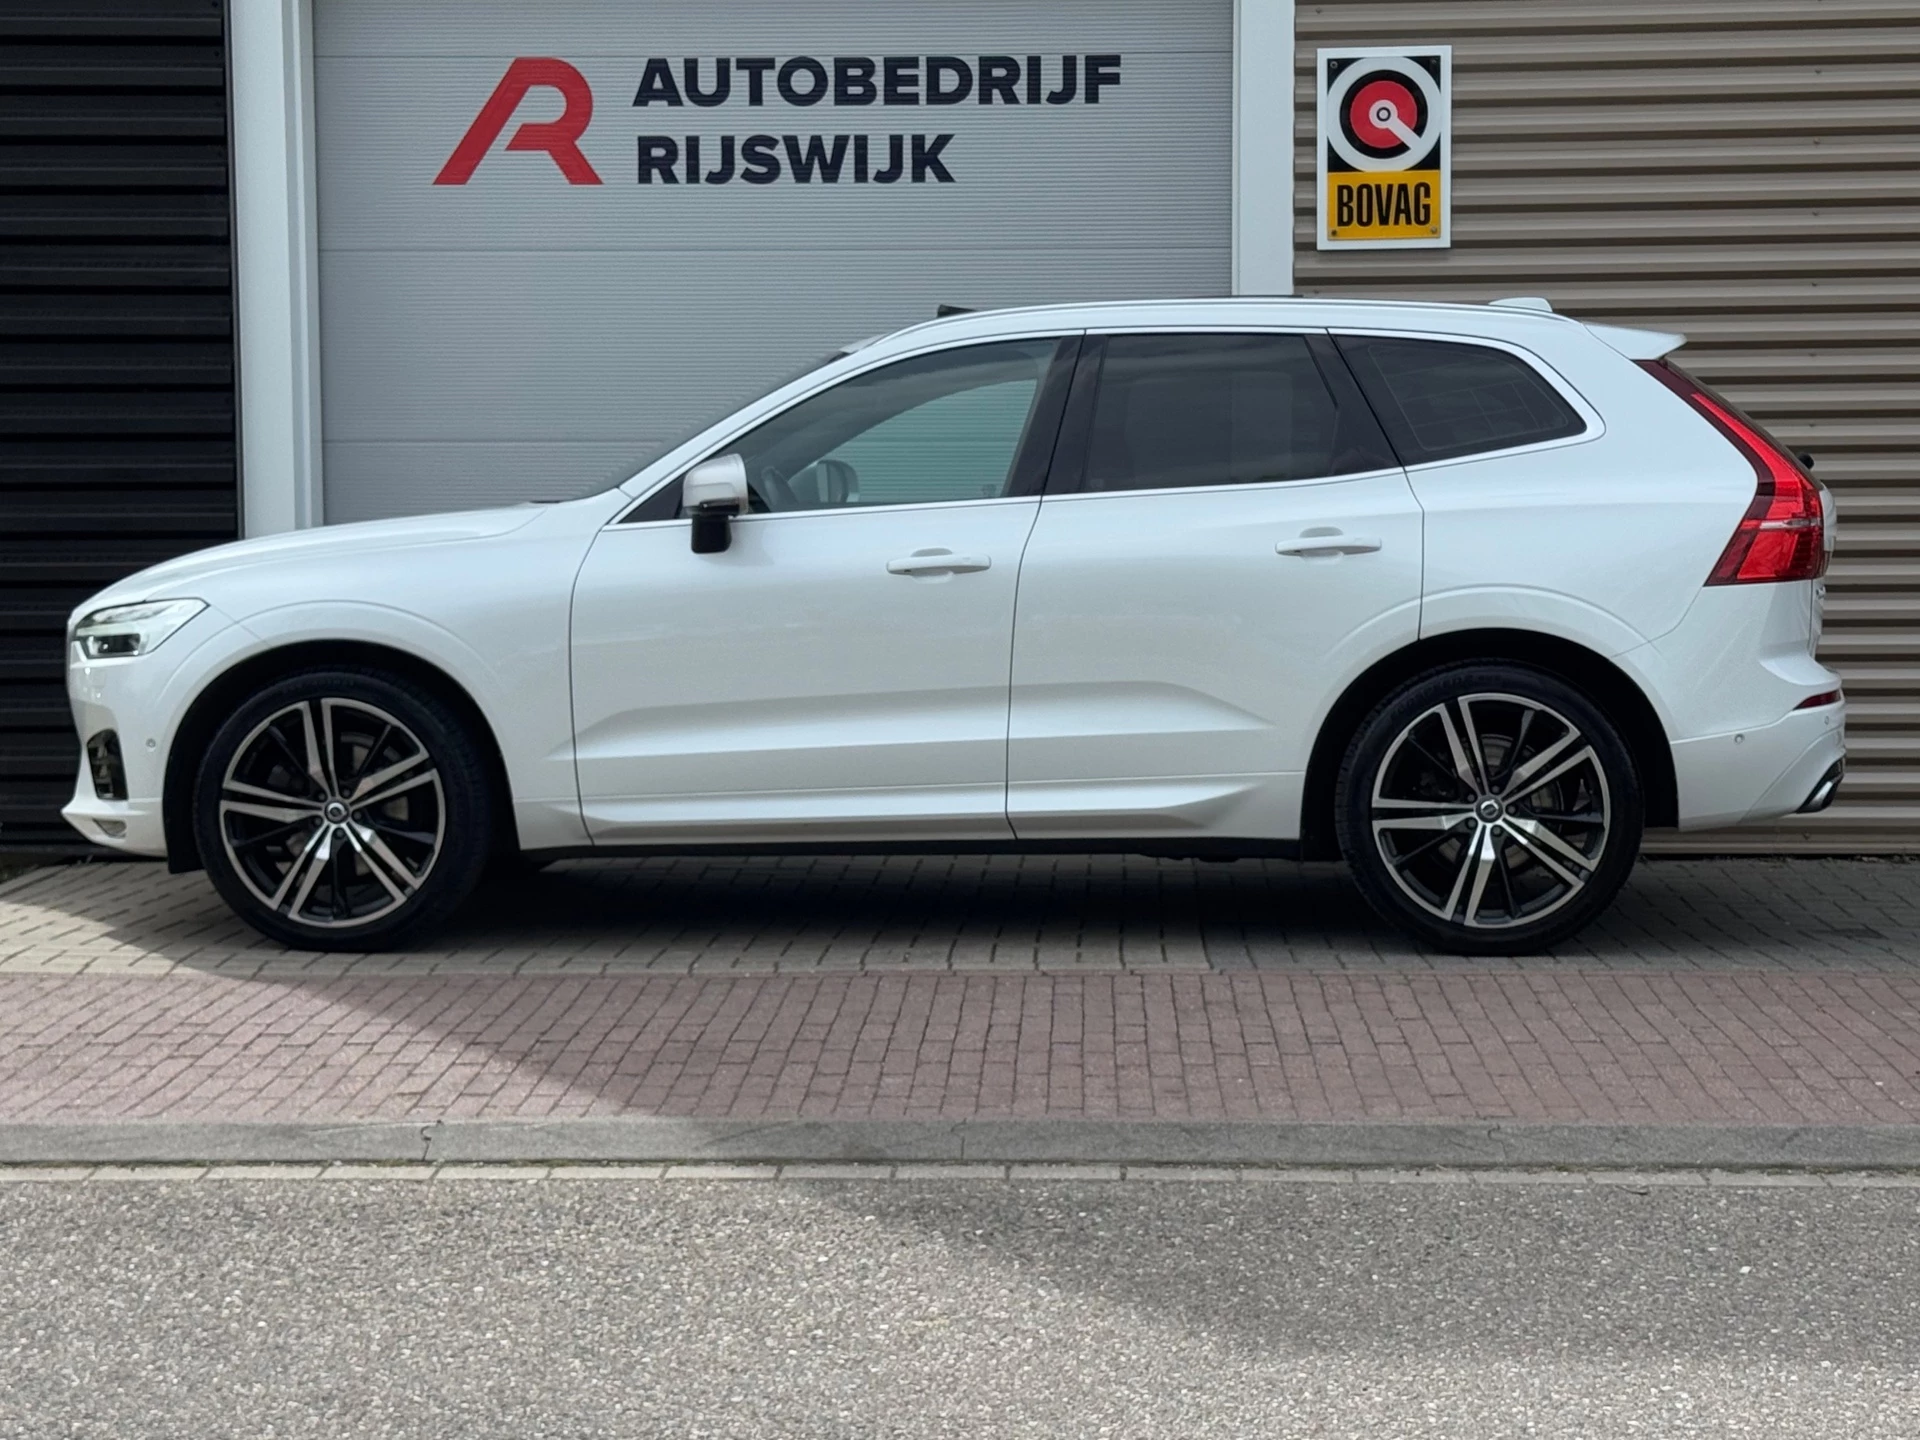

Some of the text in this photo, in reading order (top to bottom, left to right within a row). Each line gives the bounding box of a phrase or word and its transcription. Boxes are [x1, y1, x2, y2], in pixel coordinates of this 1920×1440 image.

[632, 54, 1121, 107] AUTOBEDRIJF
[637, 133, 956, 184] RIJSWIJK
[1336, 181, 1431, 228] BOVAG
